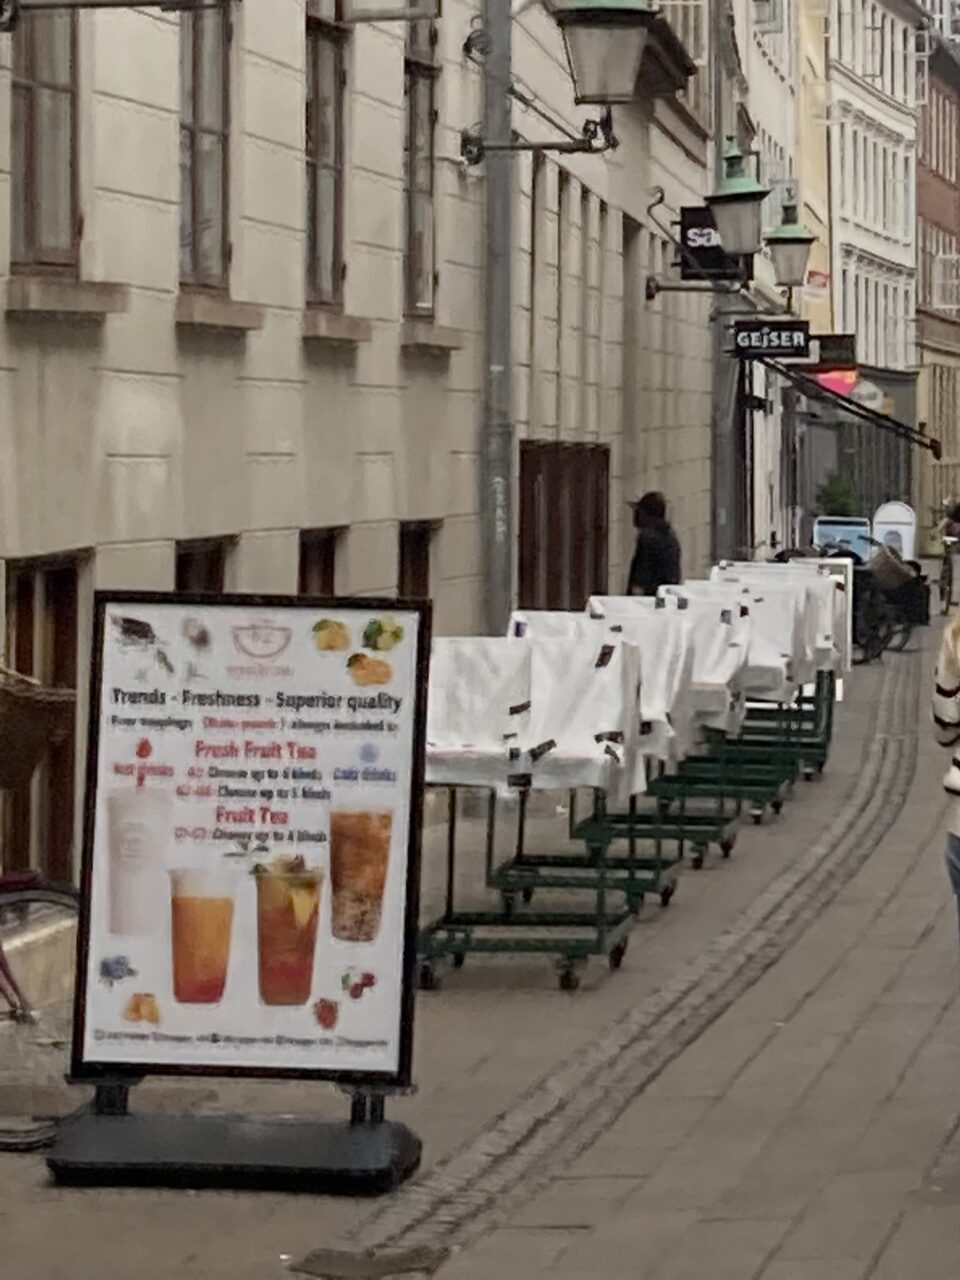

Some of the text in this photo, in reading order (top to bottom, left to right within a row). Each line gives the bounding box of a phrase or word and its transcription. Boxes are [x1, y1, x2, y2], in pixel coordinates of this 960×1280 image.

[112, 688, 166, 705] Trends
[182, 689, 260, 707] Freshness
[276, 691, 342, 712] Superior
[347, 692, 402, 713] quality
[195, 740, 317, 759] Fresh Fruit Tea
[216, 806, 288, 824] Fruit Tea
